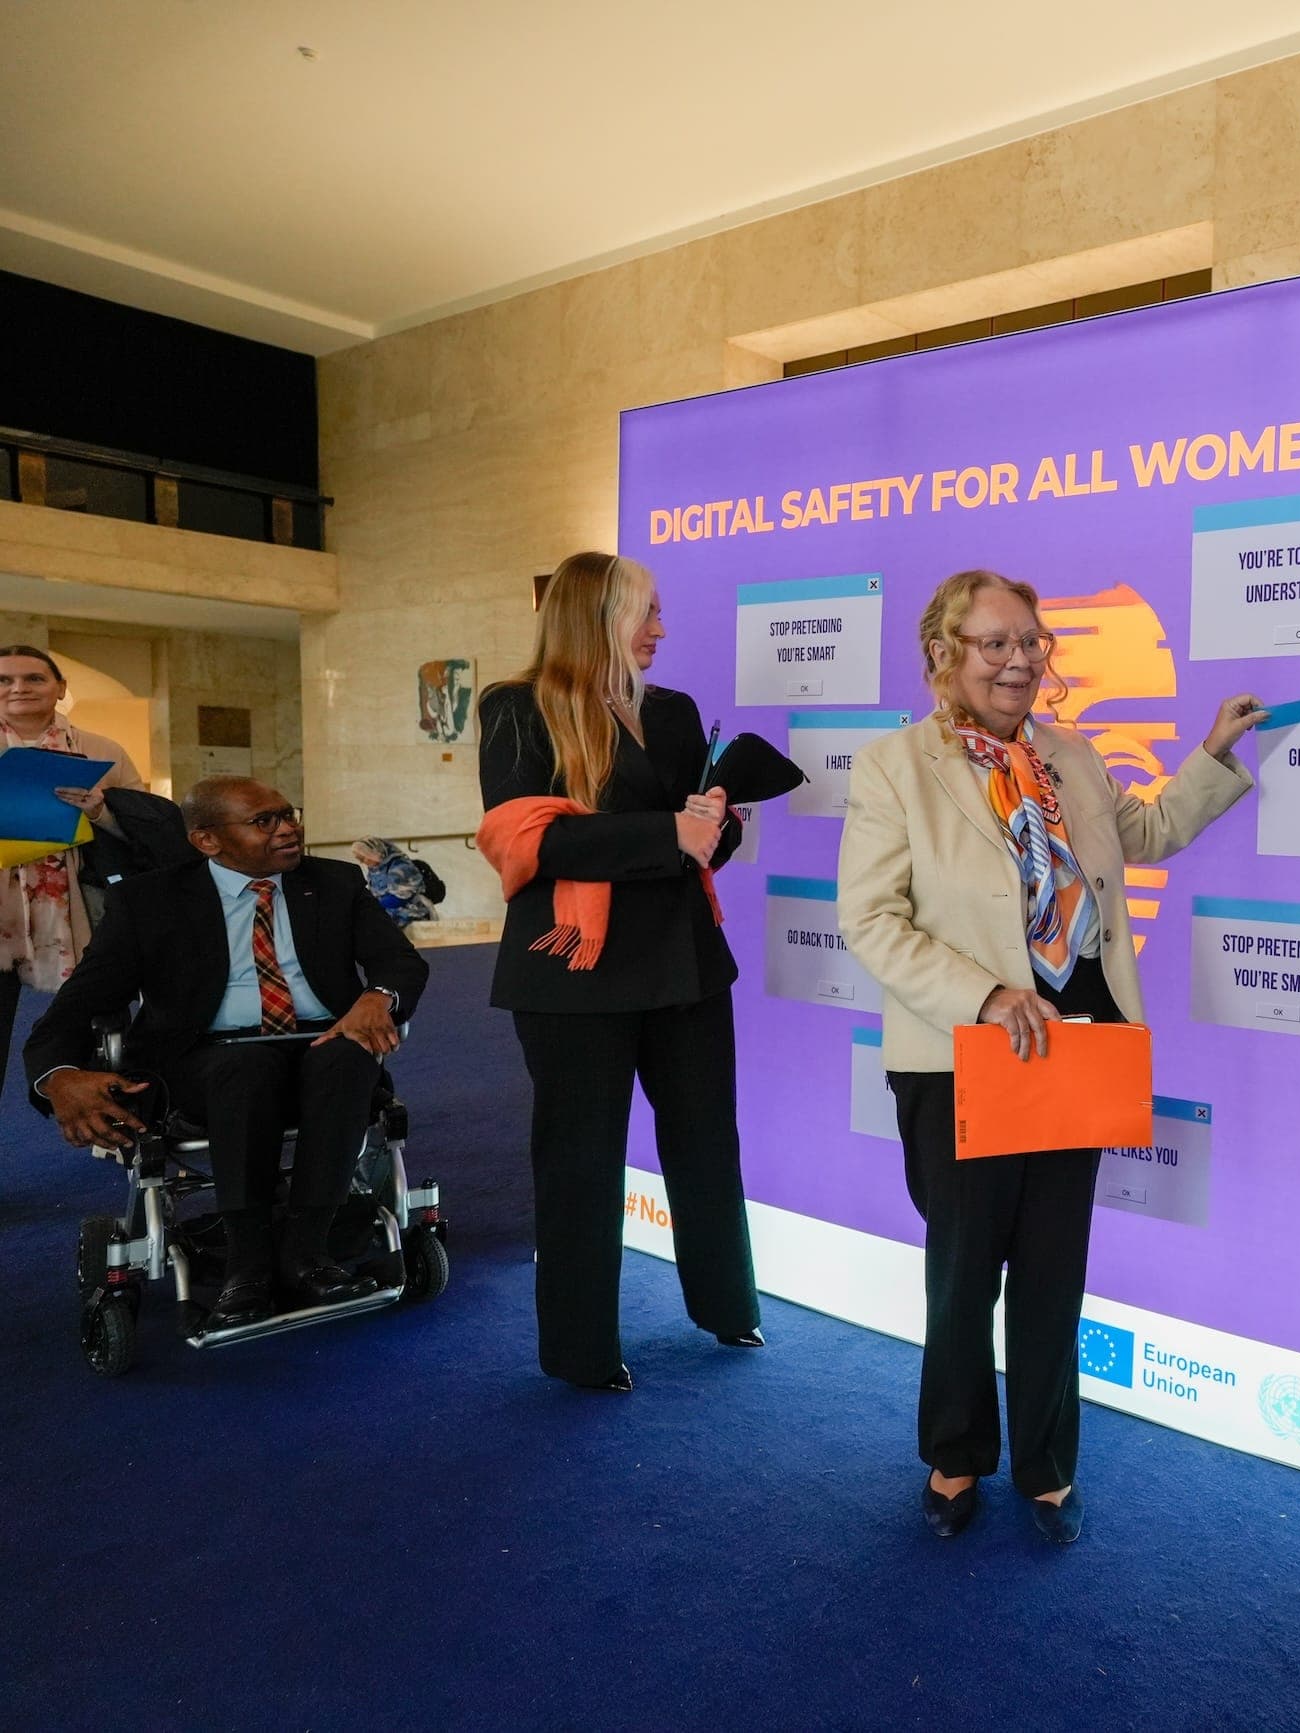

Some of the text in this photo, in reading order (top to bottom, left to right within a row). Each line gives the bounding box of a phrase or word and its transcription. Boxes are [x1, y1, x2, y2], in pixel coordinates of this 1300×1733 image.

[650, 496, 774, 544] DIGITAL
[781, 474, 923, 529] SAFETY
[932, 462, 1018, 511] FOR
[1028, 450, 1117, 500] ALL
[1239, 549, 1283, 570] YOU'RE
[769, 618, 842, 637] STOP PRETENDING
[777, 645, 836, 663] YOU'RE SMART
[800, 685, 809, 693] OK
[825, 755, 852, 770] I HATE
[787, 929, 798, 944] GO
[800, 931, 822, 948] BACK
[824, 933, 834, 949] TO
[1222, 934, 1254, 954] STOP
[1234, 968, 1278, 990] YOU'RE
[831, 986, 840, 995] OK
[1273, 1008, 1284, 1016] OK
[1121, 1146, 1152, 1162] LIKES
[1155, 1146, 1178, 1167] YOU
[1121, 1189, 1132, 1198] OK
[626, 1191, 673, 1230] #No
[1144, 1342, 1237, 1387] European
[1143, 1369, 1198, 1402] Union
